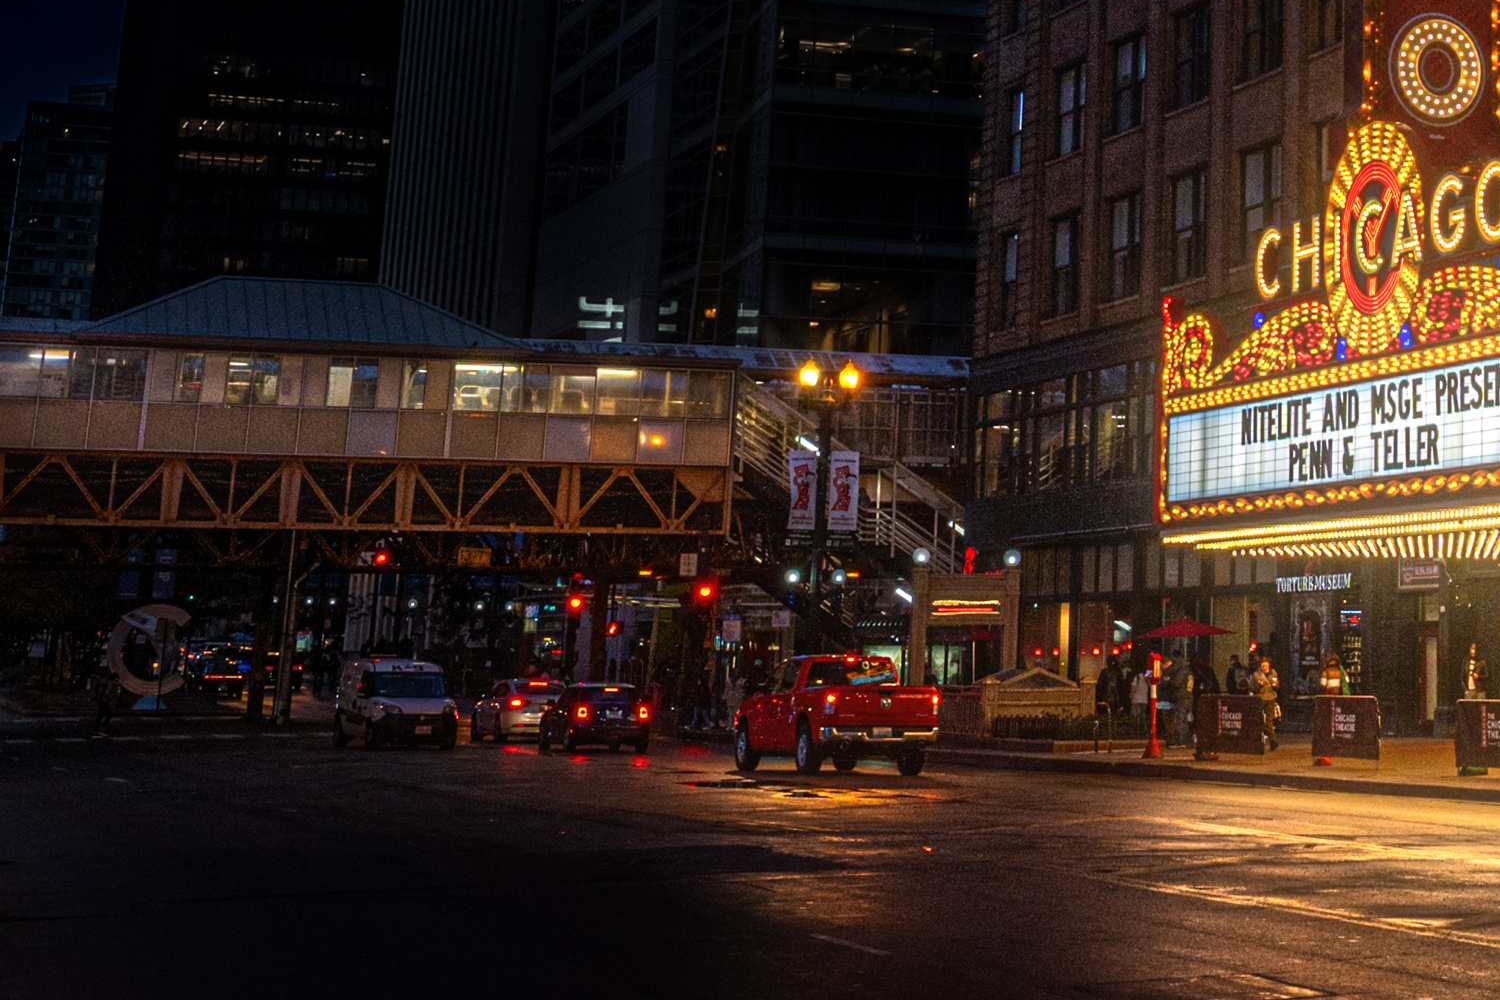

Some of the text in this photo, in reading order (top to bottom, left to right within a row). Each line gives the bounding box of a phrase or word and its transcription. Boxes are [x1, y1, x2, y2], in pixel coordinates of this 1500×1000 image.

[1241, 397, 1312, 445] NITELITE
[1322, 389, 1359, 433] AND
[1371, 377, 1423, 425] MSGE
[1289, 423, 1440, 482] PENN & TELLER
[1275, 572, 1352, 594] TORTURE MUSEUM
